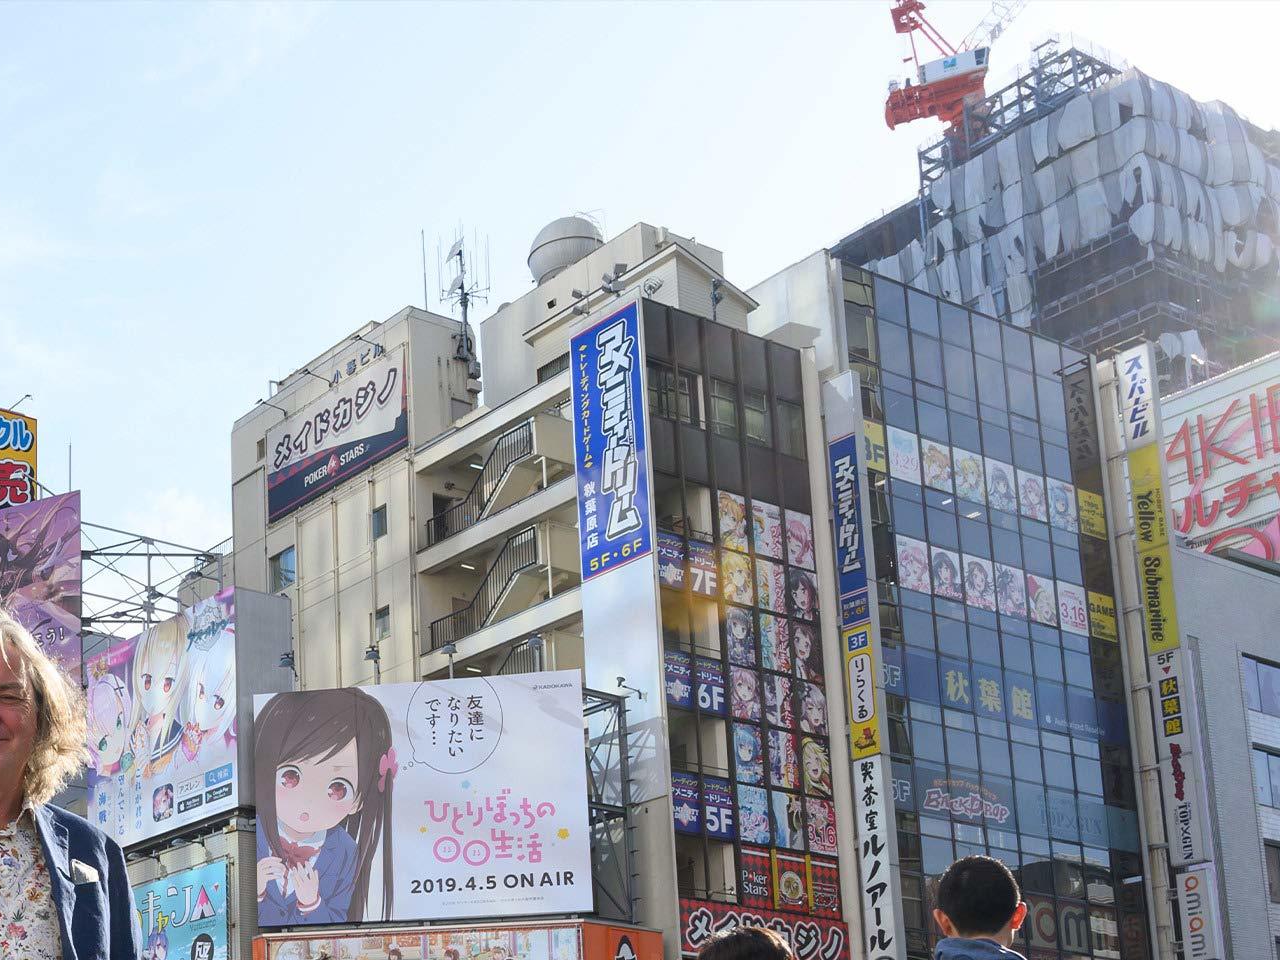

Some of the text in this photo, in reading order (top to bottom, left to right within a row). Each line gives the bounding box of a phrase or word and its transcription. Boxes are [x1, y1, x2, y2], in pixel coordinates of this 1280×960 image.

[274, 368, 397, 469] メイドカジノ
[1125, 355, 1150, 440] スーパービル
[304, 443, 365, 488] POKER STARS
[583, 482, 599, 550] 秋葉原店
[1136, 490, 1155, 542] Yellow
[690, 566, 717, 596] 7F
[1143, 555, 1164, 642] Submarine
[1090, 602, 1115, 618] GAME
[850, 633, 866, 649] 3F
[1157, 652, 1174, 666] 5F
[697, 683, 725, 711] 6F
[854, 658, 869, 720] りらくる
[946, 669, 1034, 720] 秋葉館
[1160, 678, 1182, 736] 秋葉館
[447, 696, 464, 757] なりたい
[467, 694, 484, 742] 友達に
[179, 781, 200, 793] アズレン
[424, 787, 556, 835] ひとりぼっちの
[705, 805, 733, 833] 5F
[861, 761, 893, 951] 喫茶室ルノアール
[411, 871, 574, 894] 2019.4.5 ON AIR
[743, 883, 768, 897] Stars
[1184, 874, 1207, 957] amiami
